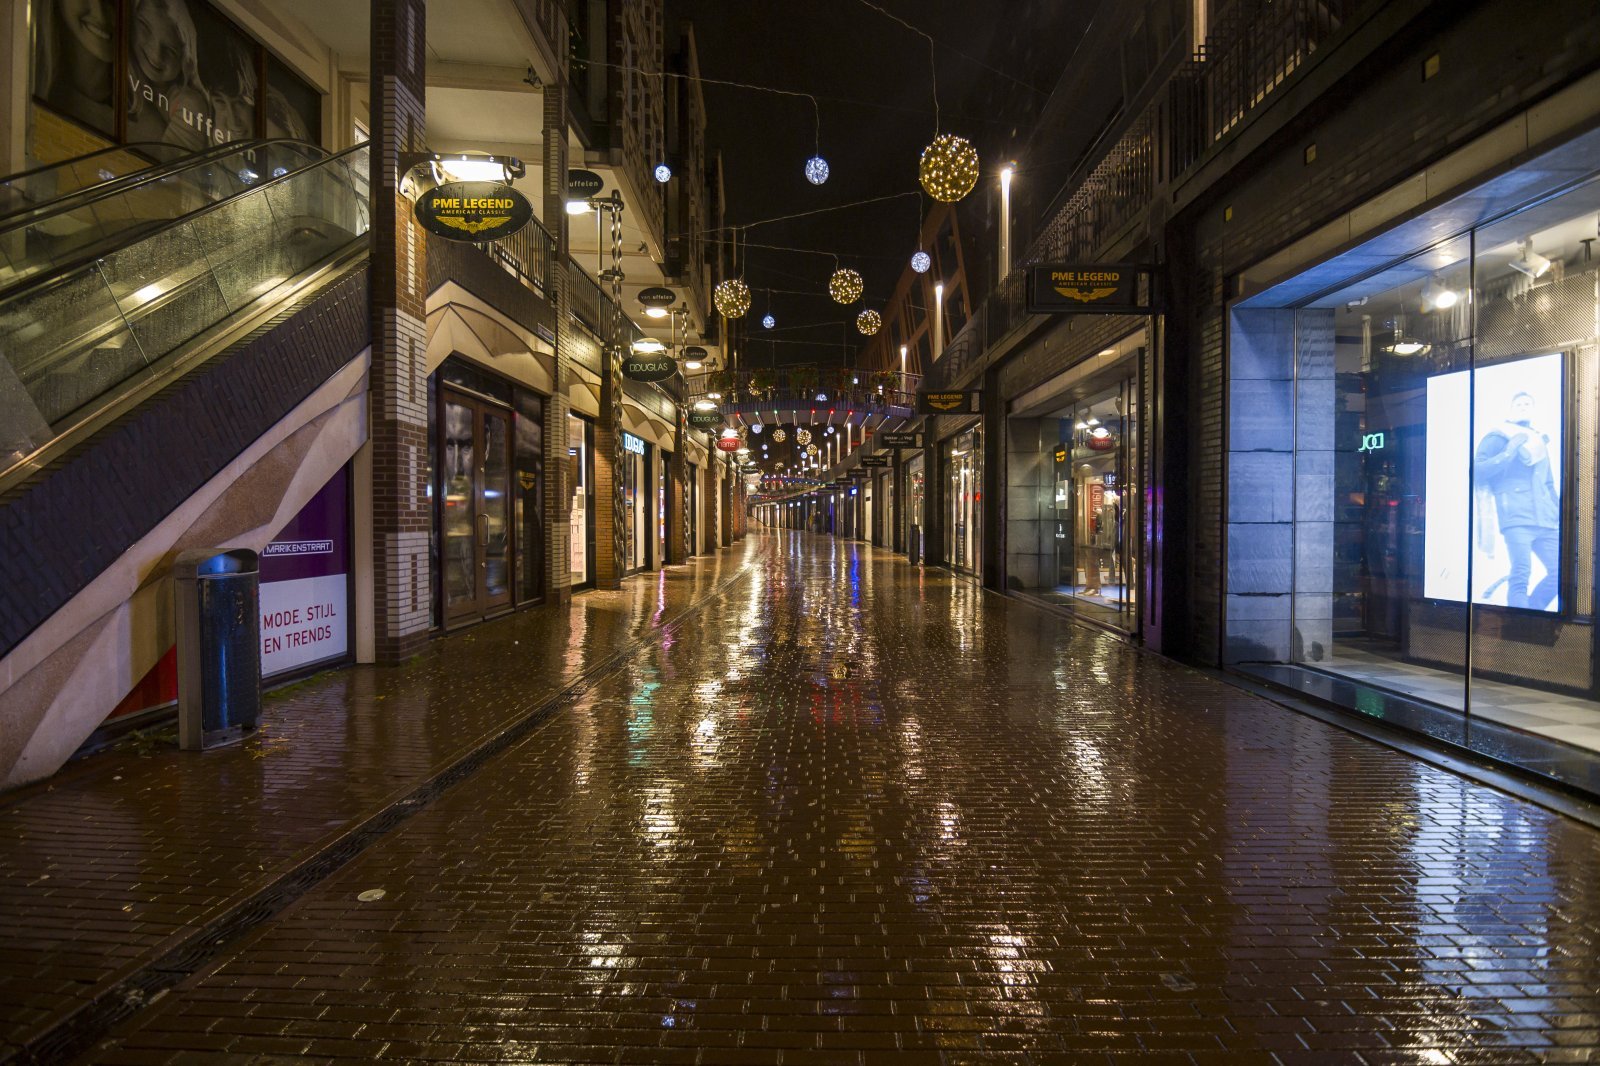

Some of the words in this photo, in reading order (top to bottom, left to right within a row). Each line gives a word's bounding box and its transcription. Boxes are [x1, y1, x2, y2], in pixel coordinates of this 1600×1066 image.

[130, 75, 168, 111] van
[183, 108, 256, 163] uffeln
[433, 198, 460, 209] PME
[463, 198, 514, 209] LEGEND
[1051, 272, 1075, 281] PME
[1077, 272, 1120, 281] LEGEND
[629, 362, 669, 372] DOUGLAS
[266, 542, 330, 553] MARIKENSTRAAT
[263, 609, 303, 630] MODE,
[307, 603, 336, 621] STIJL
[264, 636, 281, 654] EN
[285, 625, 332, 648] TRENDS
